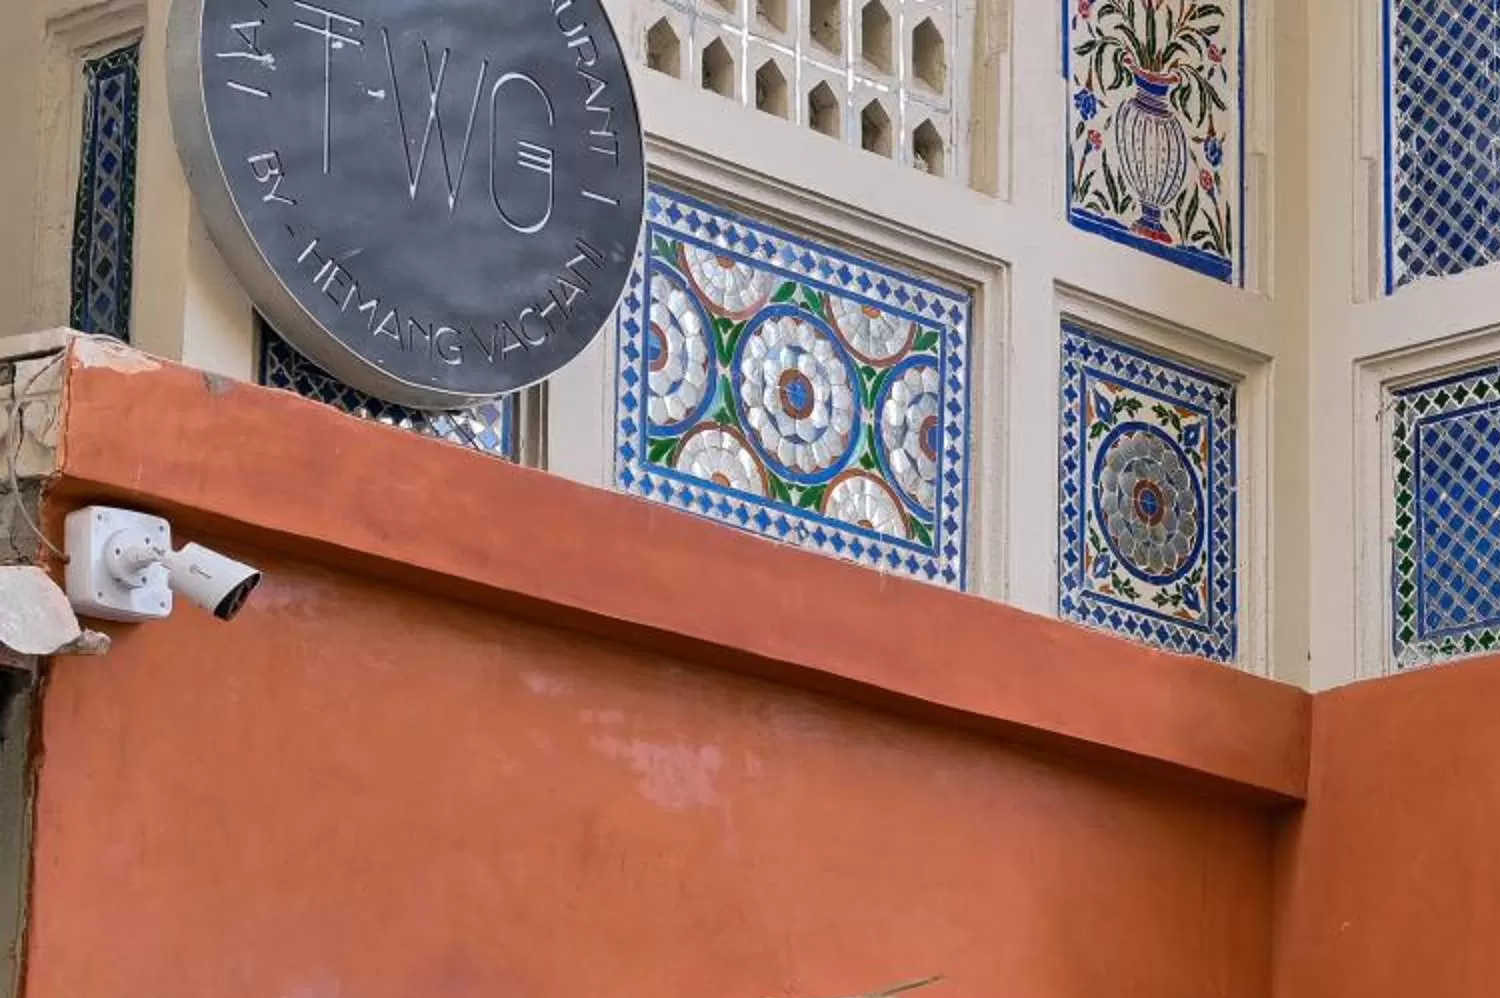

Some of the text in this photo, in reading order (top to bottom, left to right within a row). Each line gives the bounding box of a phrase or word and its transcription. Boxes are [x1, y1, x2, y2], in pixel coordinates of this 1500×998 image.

[551, 0, 621, 168] URANT
[247, 150, 604, 367] BY HEMANG VACHANI
